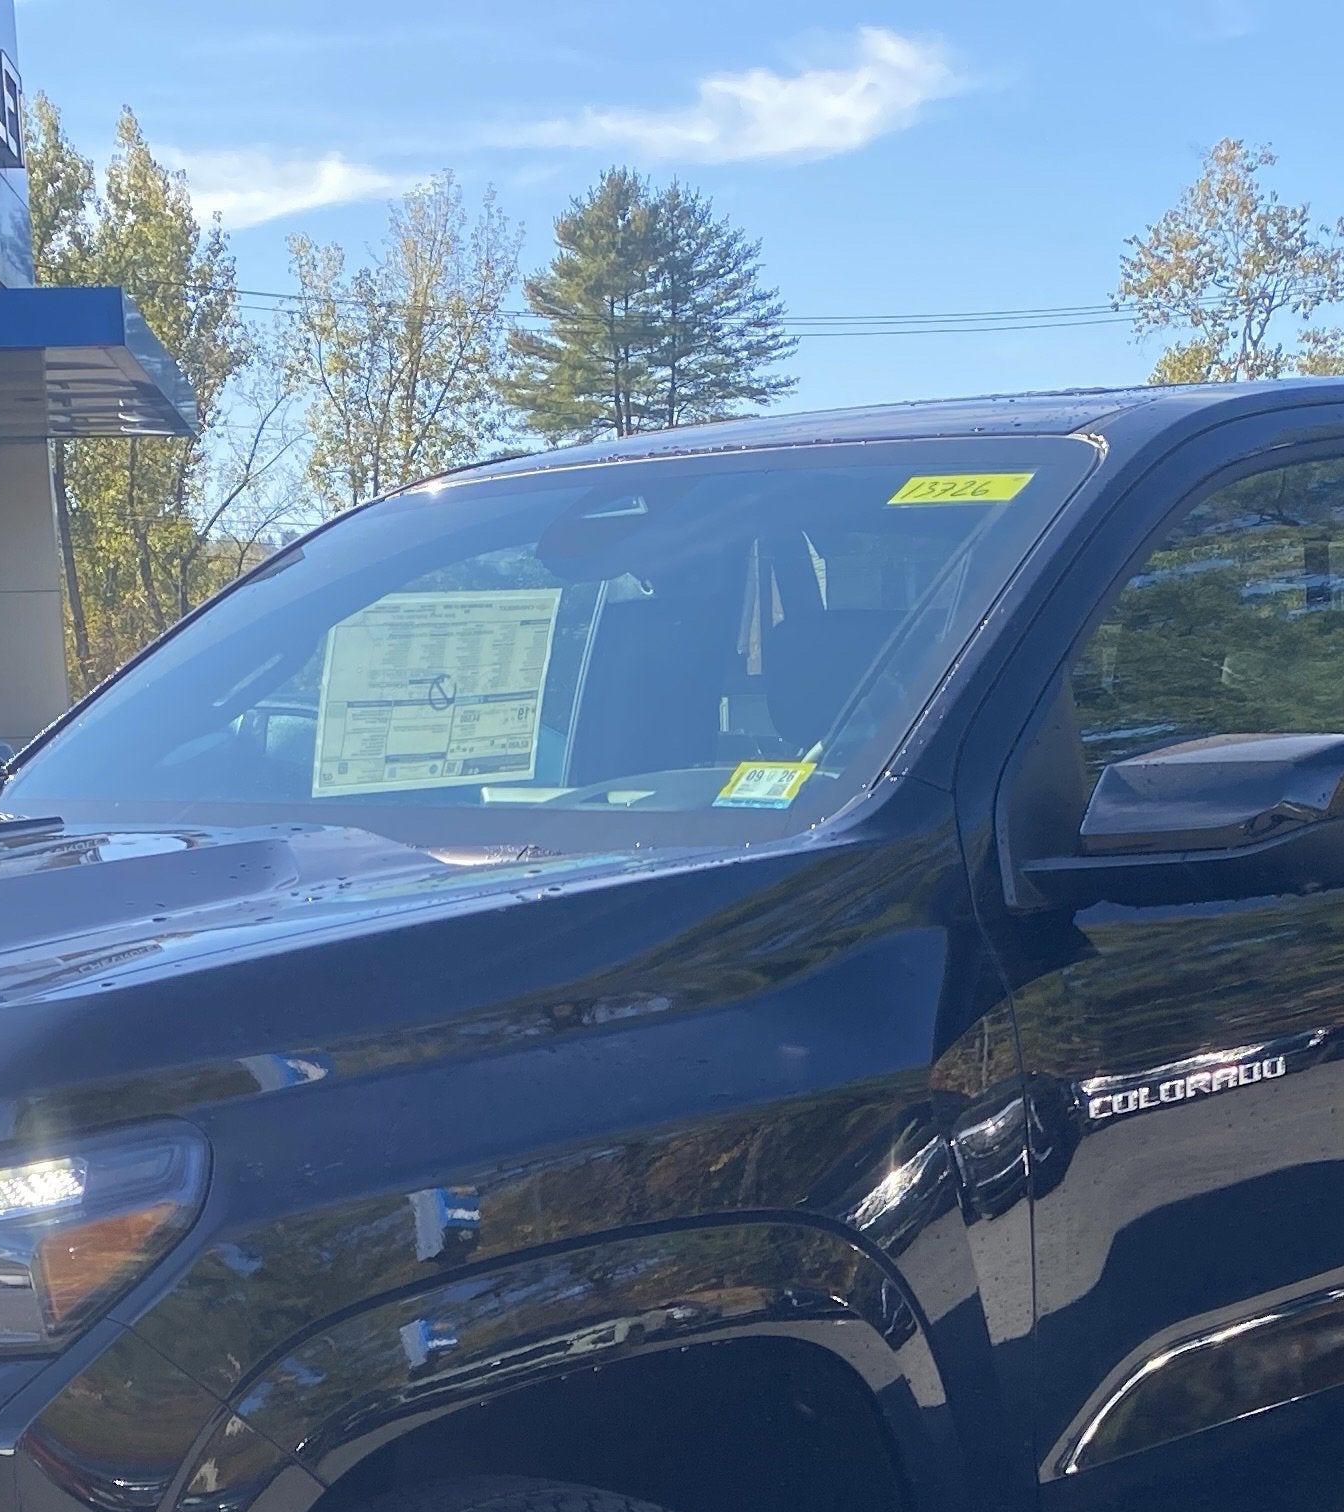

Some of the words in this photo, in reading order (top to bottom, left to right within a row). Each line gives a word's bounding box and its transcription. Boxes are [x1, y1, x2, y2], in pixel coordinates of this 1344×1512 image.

[901, 480, 991, 499] 13726
[746, 769, 765, 782] 09
[1088, 1056, 1287, 1119] COLORADO
